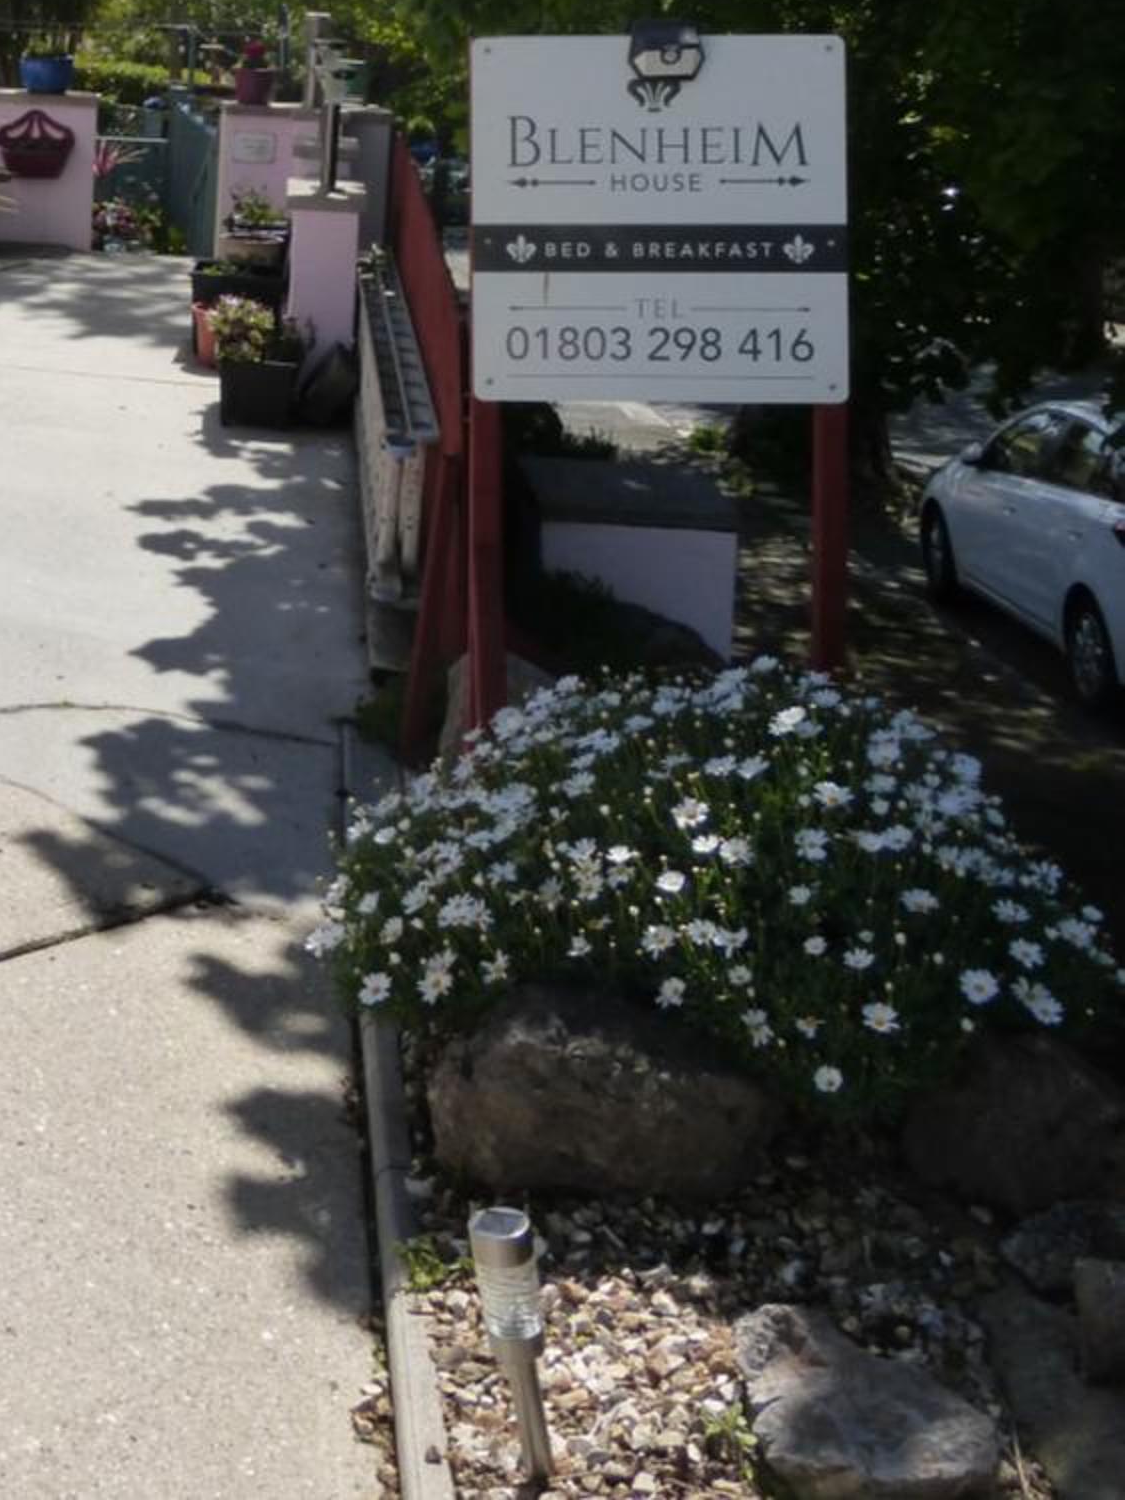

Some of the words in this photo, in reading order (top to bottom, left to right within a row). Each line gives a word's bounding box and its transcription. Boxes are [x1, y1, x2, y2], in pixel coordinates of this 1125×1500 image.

[507, 115, 810, 168] BLENHEIM
[610, 173, 703, 193] HOUSE
[544, 242, 591, 259] BED
[604, 242, 619, 259] &
[632, 242, 774, 259] BREAKFAST
[635, 298, 683, 320] TEL
[506, 326, 632, 362] 01803
[647, 326, 723, 363] 298
[738, 328, 815, 363] 416
